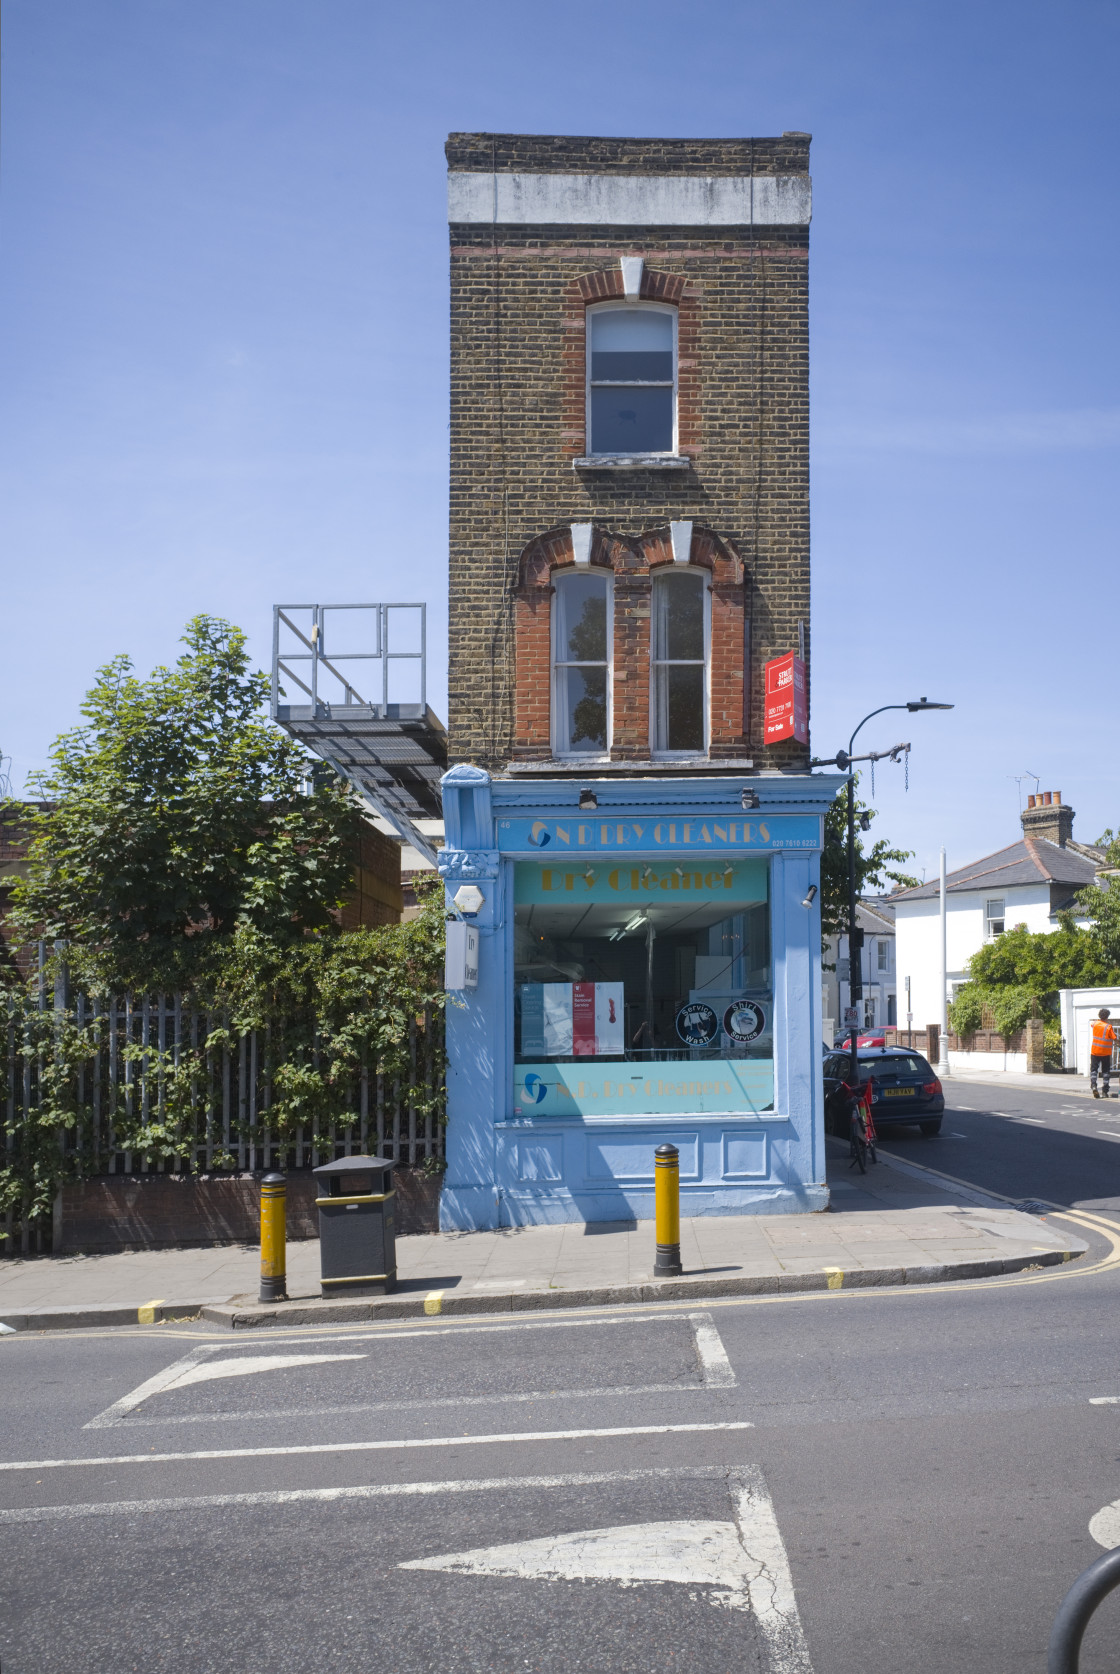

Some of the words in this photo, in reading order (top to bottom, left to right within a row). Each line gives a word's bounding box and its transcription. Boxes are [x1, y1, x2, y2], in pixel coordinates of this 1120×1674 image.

[775, 723, 783, 731] Sale
[500, 821, 511, 829] 46
[556, 825, 570, 845] N
[578, 825, 593, 845] D
[600, 824, 647, 845] DRY
[654, 822, 770, 845] CLEANERS
[772, 839, 784, 847] 020
[802, 839, 817, 847] 6222
[542, 869, 600, 891] Dry
[608, 869, 740, 891] Cleaner
[681, 1005, 713, 1018] Service
[732, 1002, 757, 1012] Shirt
[685, 1035, 710, 1044] Wash
[730, 1031, 758, 1041] Service
[603, 1081, 638, 1098] Dry
[644, 1079, 733, 1098] Cleaners
